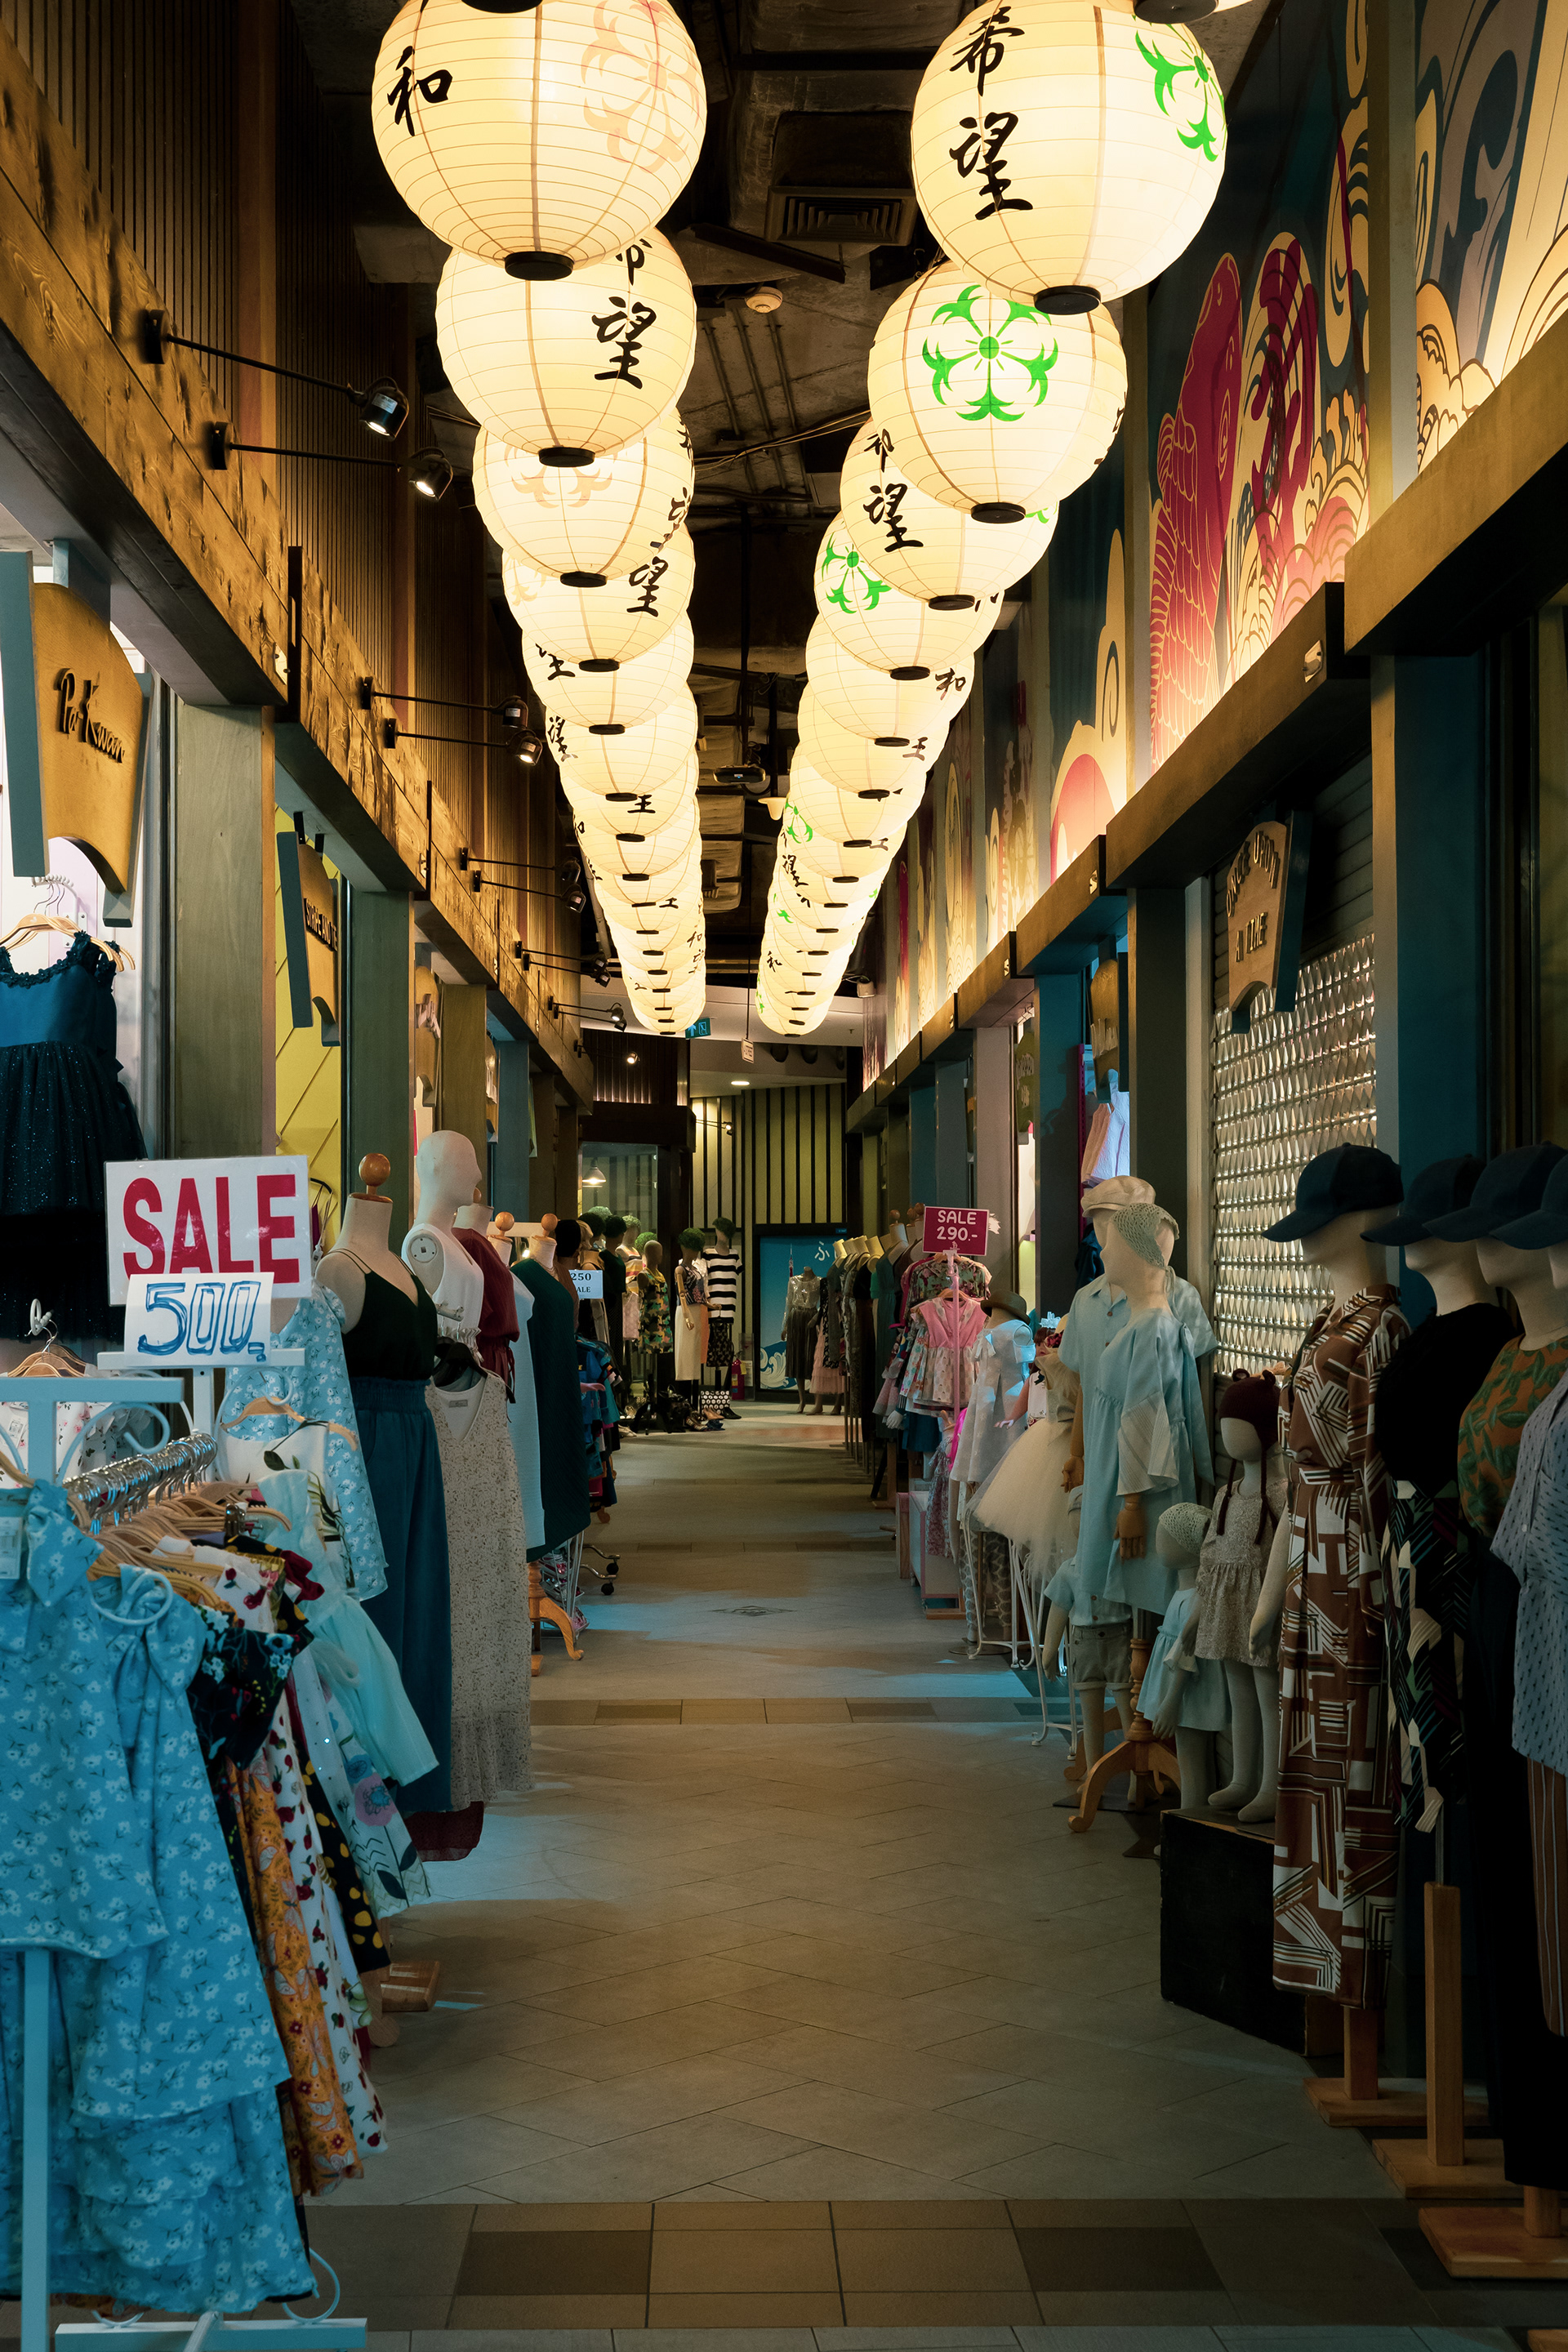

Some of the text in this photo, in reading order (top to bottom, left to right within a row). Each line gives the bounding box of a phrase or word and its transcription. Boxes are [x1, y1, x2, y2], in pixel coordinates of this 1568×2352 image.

[387, 0, 452, 136] 和
[949, 7, 1033, 220] 希望
[1226, 831, 1280, 917] ONCE UPON
[1235, 912, 1267, 962] A TIME
[122, 1174, 300, 1283] SALE
[937, 1226, 978, 1241] 290.-
[938, 1209, 977, 1225] SALE
[570, 1272, 591, 1281] 250
